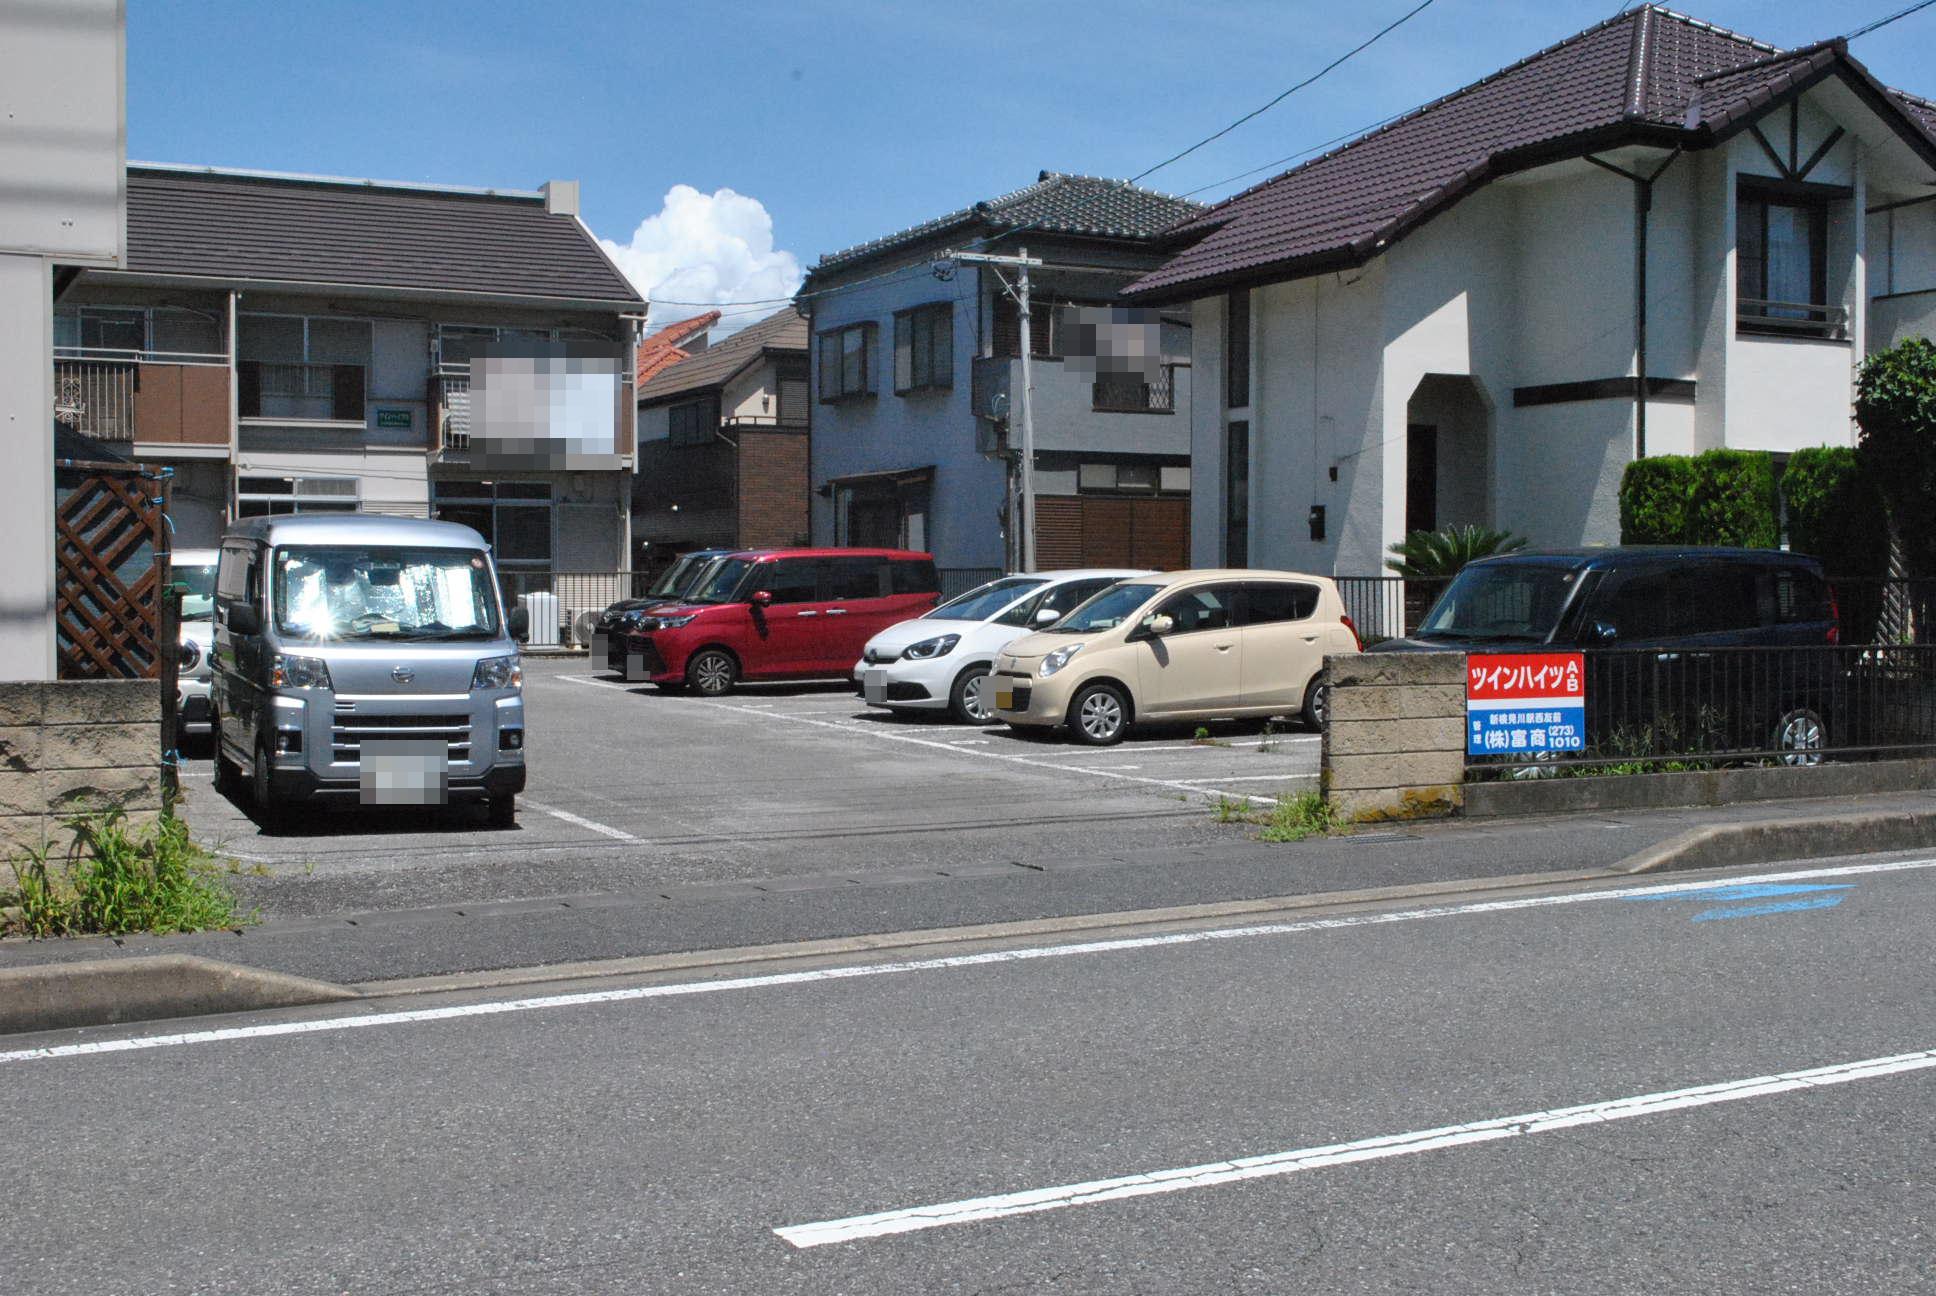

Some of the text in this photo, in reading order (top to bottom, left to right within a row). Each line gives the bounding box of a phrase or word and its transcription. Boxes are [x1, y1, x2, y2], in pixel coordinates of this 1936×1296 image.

[1471, 664, 1564, 691] ツインハイツ
[1548, 725, 1574, 736] (273)
[1549, 736, 1580, 748] 1010
